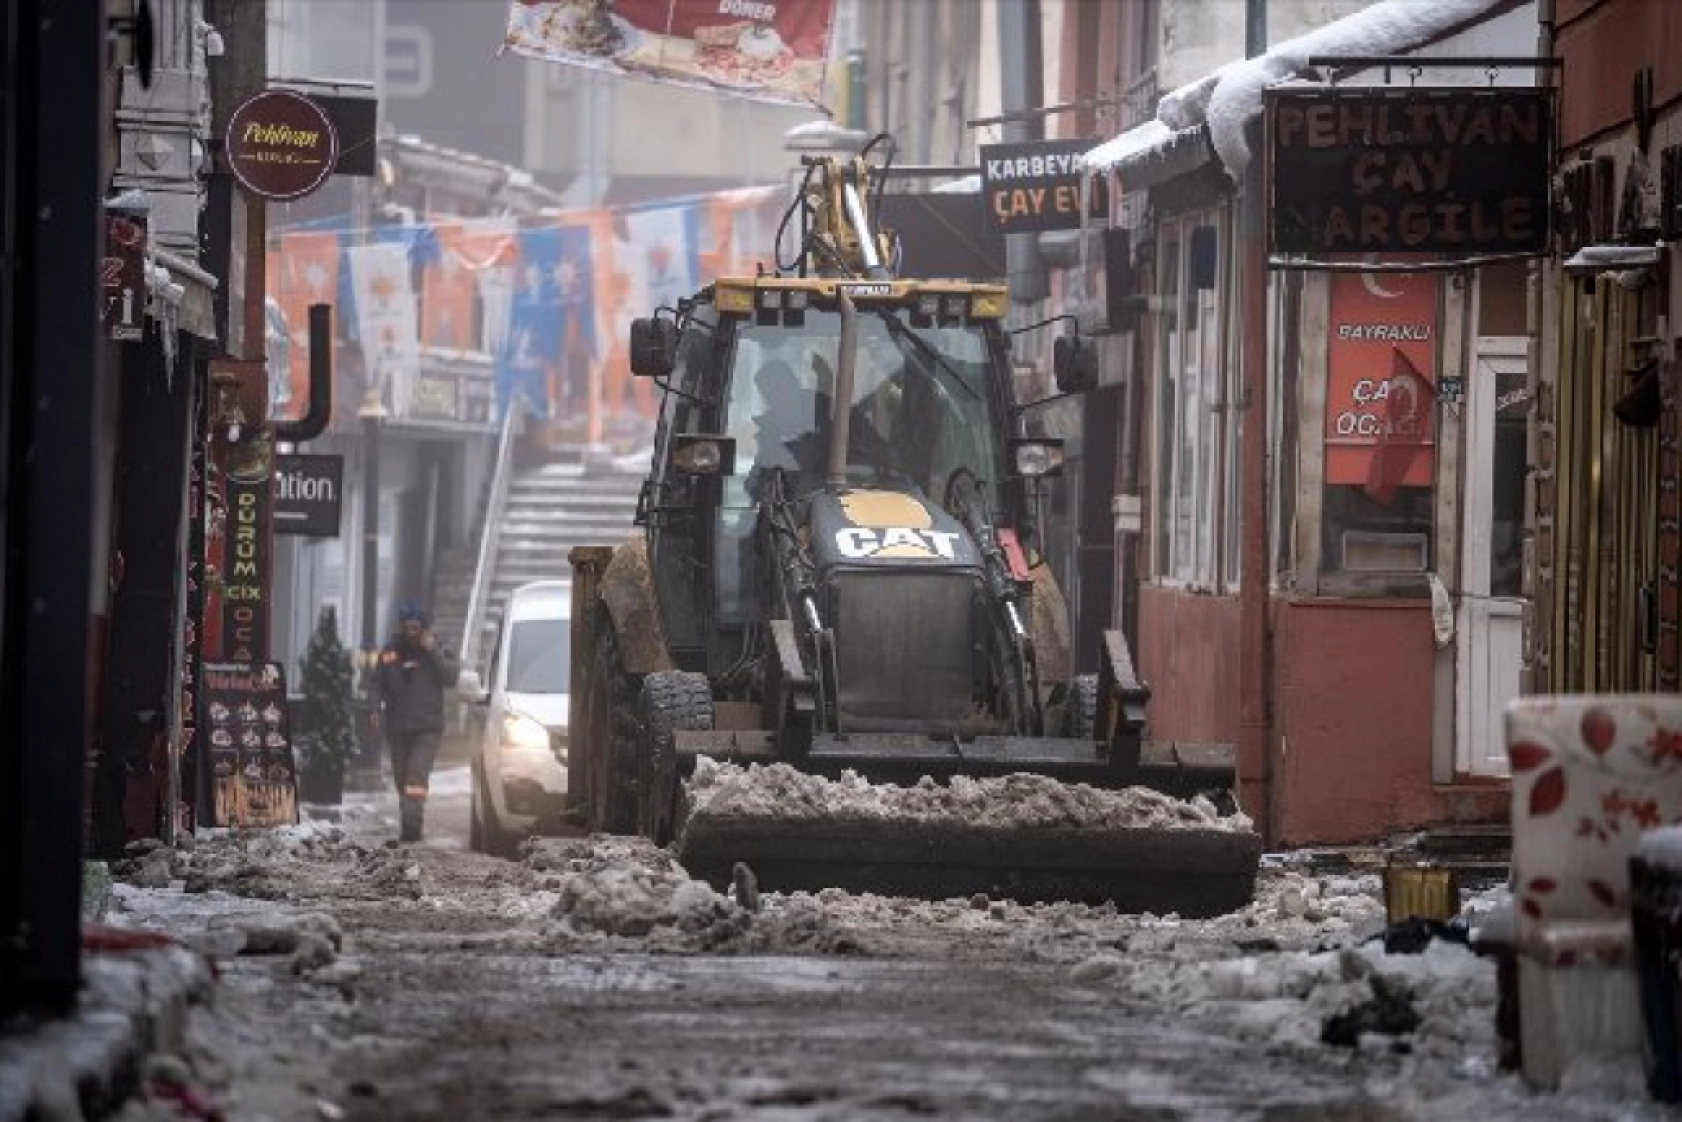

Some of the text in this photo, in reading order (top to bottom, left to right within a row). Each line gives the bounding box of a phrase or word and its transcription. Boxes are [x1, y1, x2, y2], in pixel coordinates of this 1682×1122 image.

[994, 188, 1046, 225] ÇAY
[1339, 325, 1431, 340] BAYRAKLI
[835, 527, 959, 559] CAT
